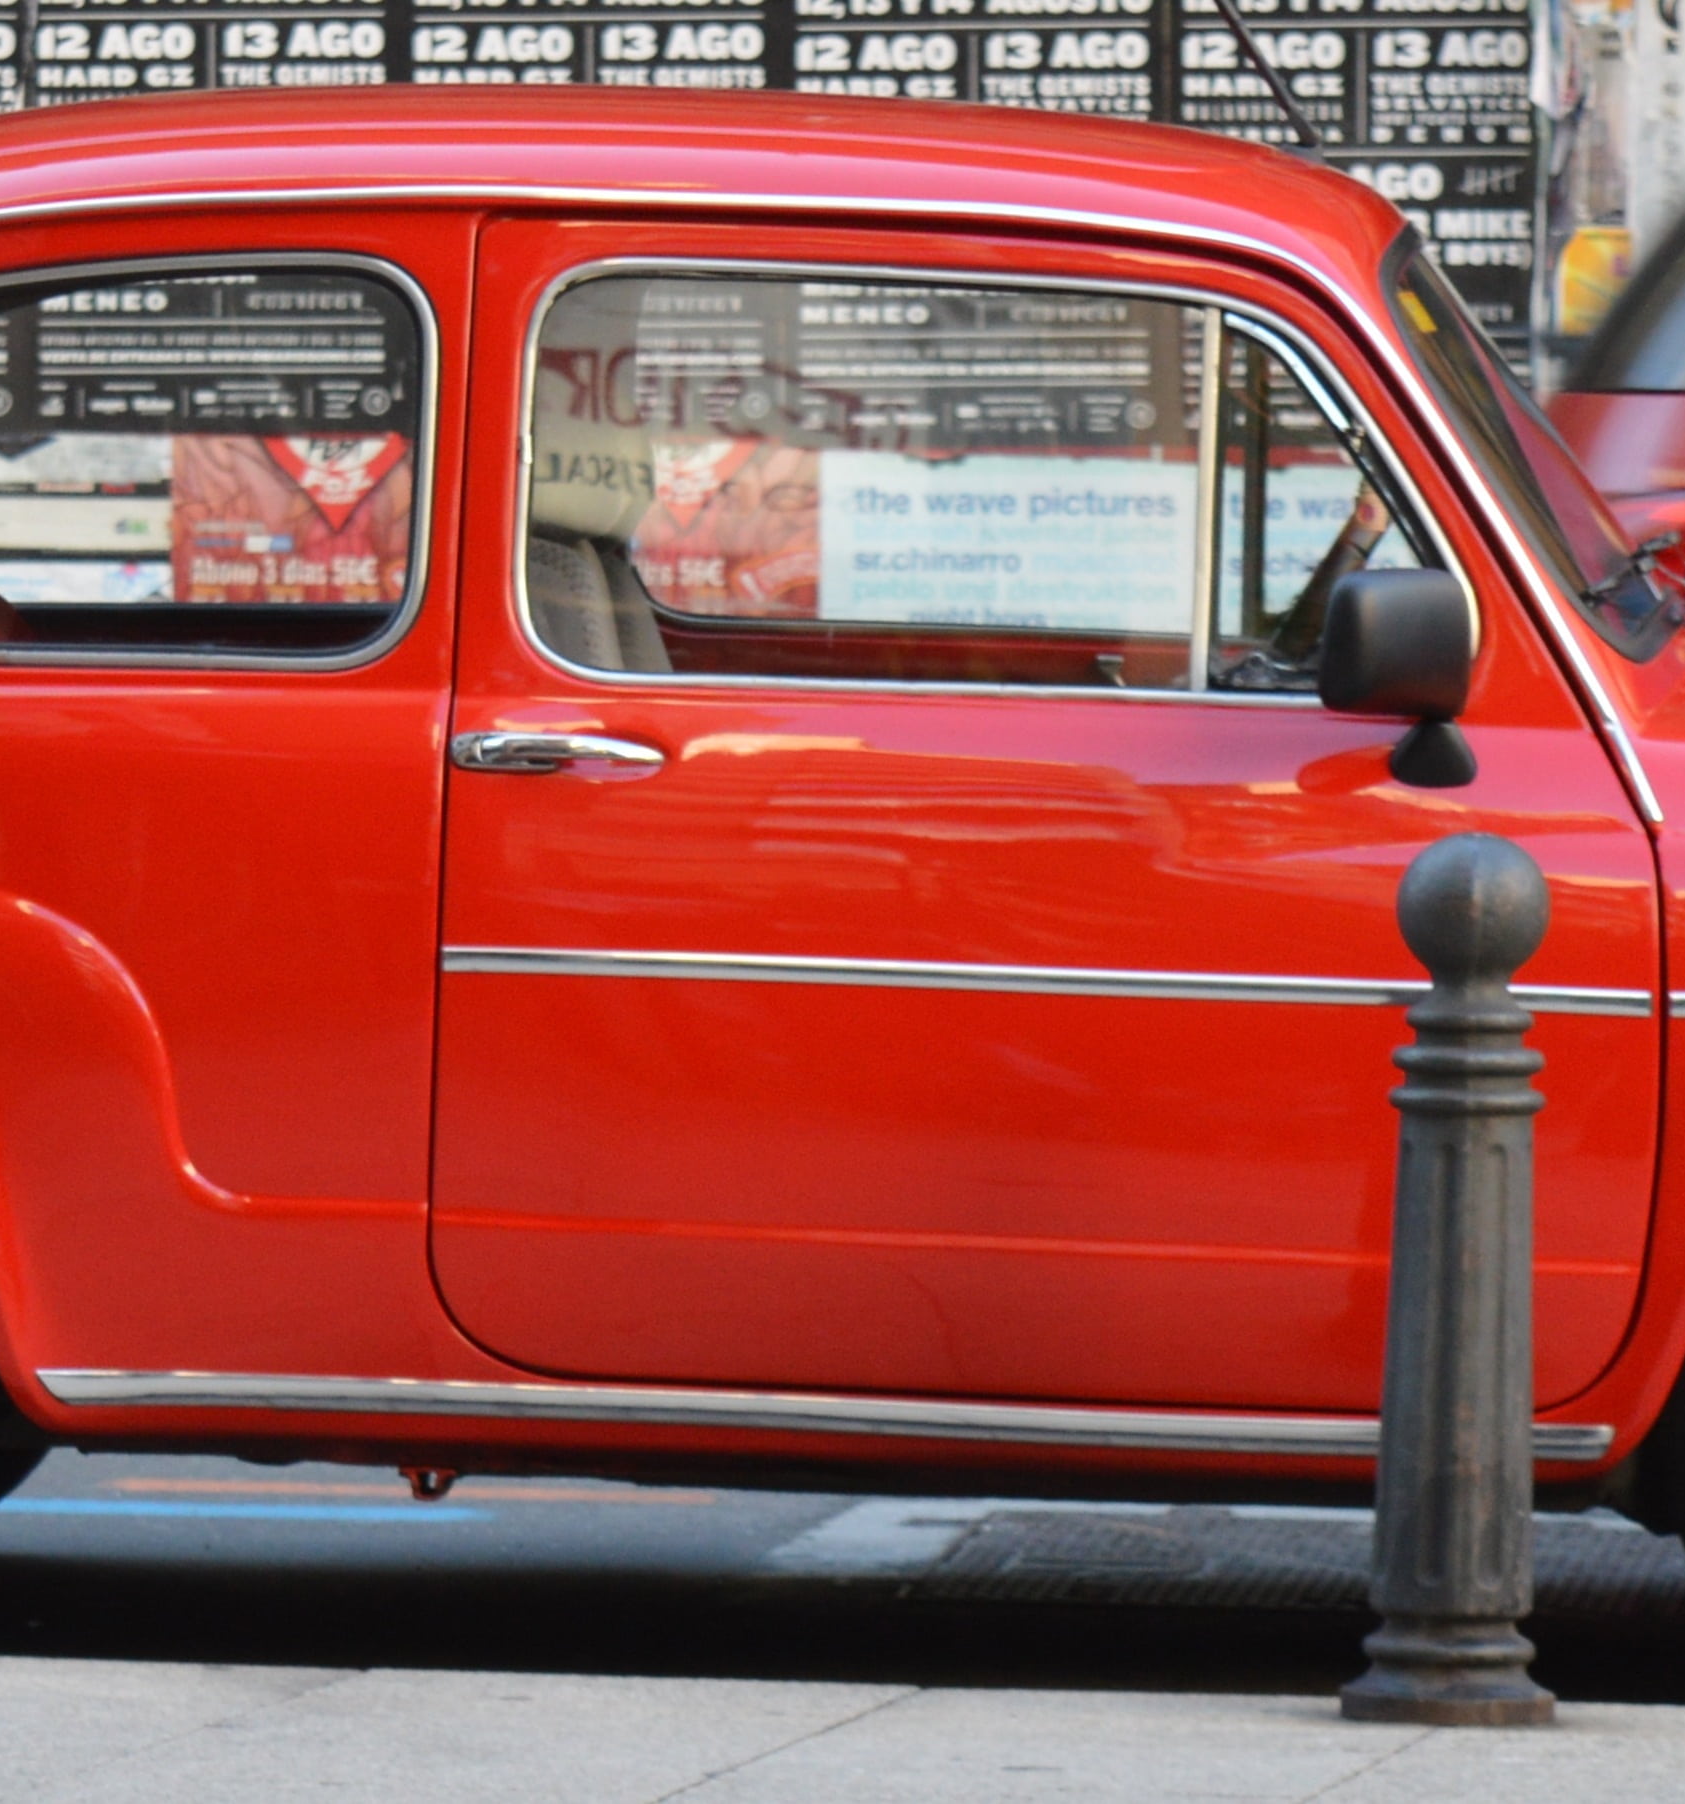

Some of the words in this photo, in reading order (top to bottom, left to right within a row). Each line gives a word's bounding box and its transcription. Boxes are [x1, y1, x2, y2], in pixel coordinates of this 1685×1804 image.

[36, 21, 90, 60] 12
[97, 22, 197, 60] AGO
[222, 21, 279, 58] 13
[286, 21, 386, 58] AGO
[411, 25, 468, 62] 12
[474, 25, 575, 62] AGO
[600, 23, 657, 61] 13
[665, 23, 765, 61] AGO
[794, 33, 851, 72] 12
[857, 33, 958, 72] AGO
[984, 31, 1042, 69] 13
[1048, 31, 1151, 69] AGO
[1181, 31, 1238, 69] 12
[1372, 31, 1431, 67] 13
[1438, 31, 1528, 67] AGO
[37, 65, 137, 88] HARD
[221, 64, 271, 85] THE
[598, 66, 651, 86] THE
[983, 74, 1034, 97] THE
[1371, 73, 1422, 96] THE
[1434, 209, 1531, 240] MIKE
[41, 289, 167, 312] MENEO
[800, 303, 930, 325] MENEO
[853, 488, 911, 515] the
[922, 494, 1016, 515] wave
[1029, 488, 1177, 525] pictures
[853, 548, 1023, 573] sr.chinarro
